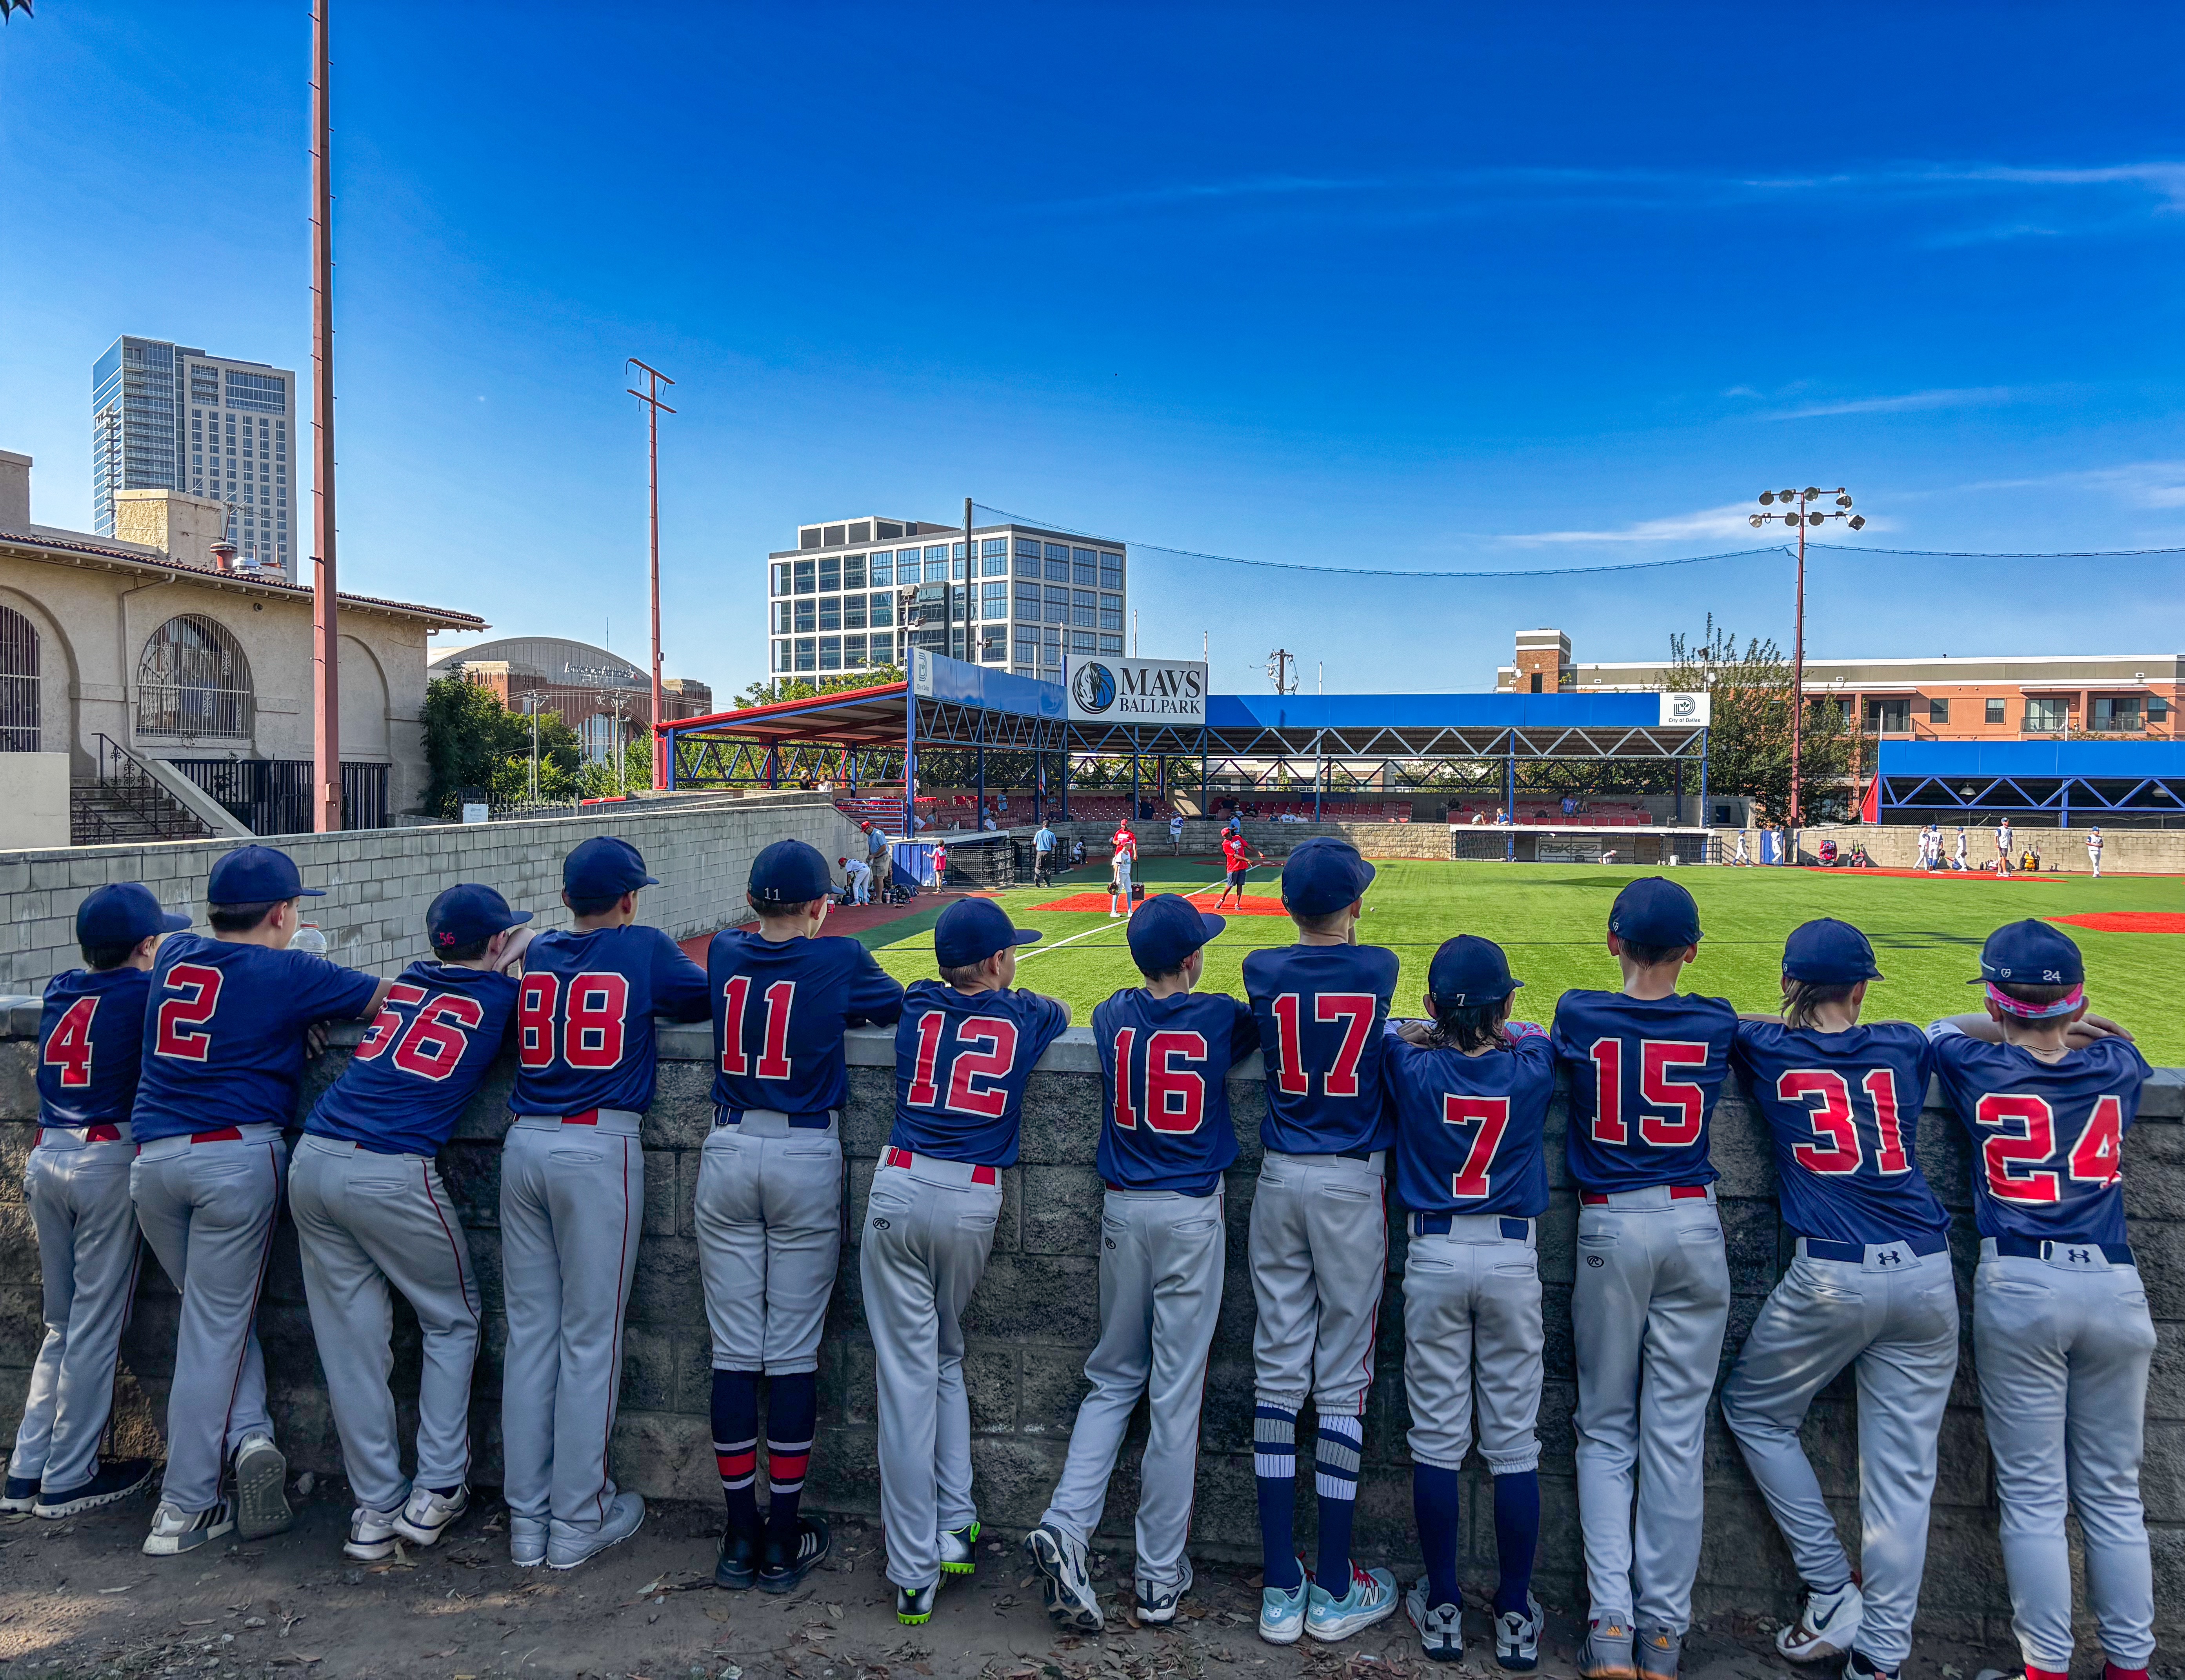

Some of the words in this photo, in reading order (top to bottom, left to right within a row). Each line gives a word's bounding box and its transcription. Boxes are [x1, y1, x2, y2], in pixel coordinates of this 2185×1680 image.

[1119, 698, 1201, 714] BALLPARK
[1120, 667, 1200, 698] MAVS
[440, 932, 455, 946] 56
[765, 887, 780, 900] 11
[155, 962, 224, 1062] 2
[518, 971, 629, 1069] 88
[1456, 994, 1465, 1006] 7
[2043, 967, 2061, 984] 24
[44, 996, 101, 1087] 4
[354, 982, 484, 1082] 56
[721, 975, 796, 1080] 11
[907, 1011, 1019, 1118] 12
[1272, 992, 1377, 1097] 17
[1113, 1027, 1207, 1135] 16
[1590, 1037, 1709, 1147] 15
[1776, 1068, 1912, 1175] 31
[1443, 1093, 1511, 1198] 7
[1975, 1093, 2123, 1204] 24
